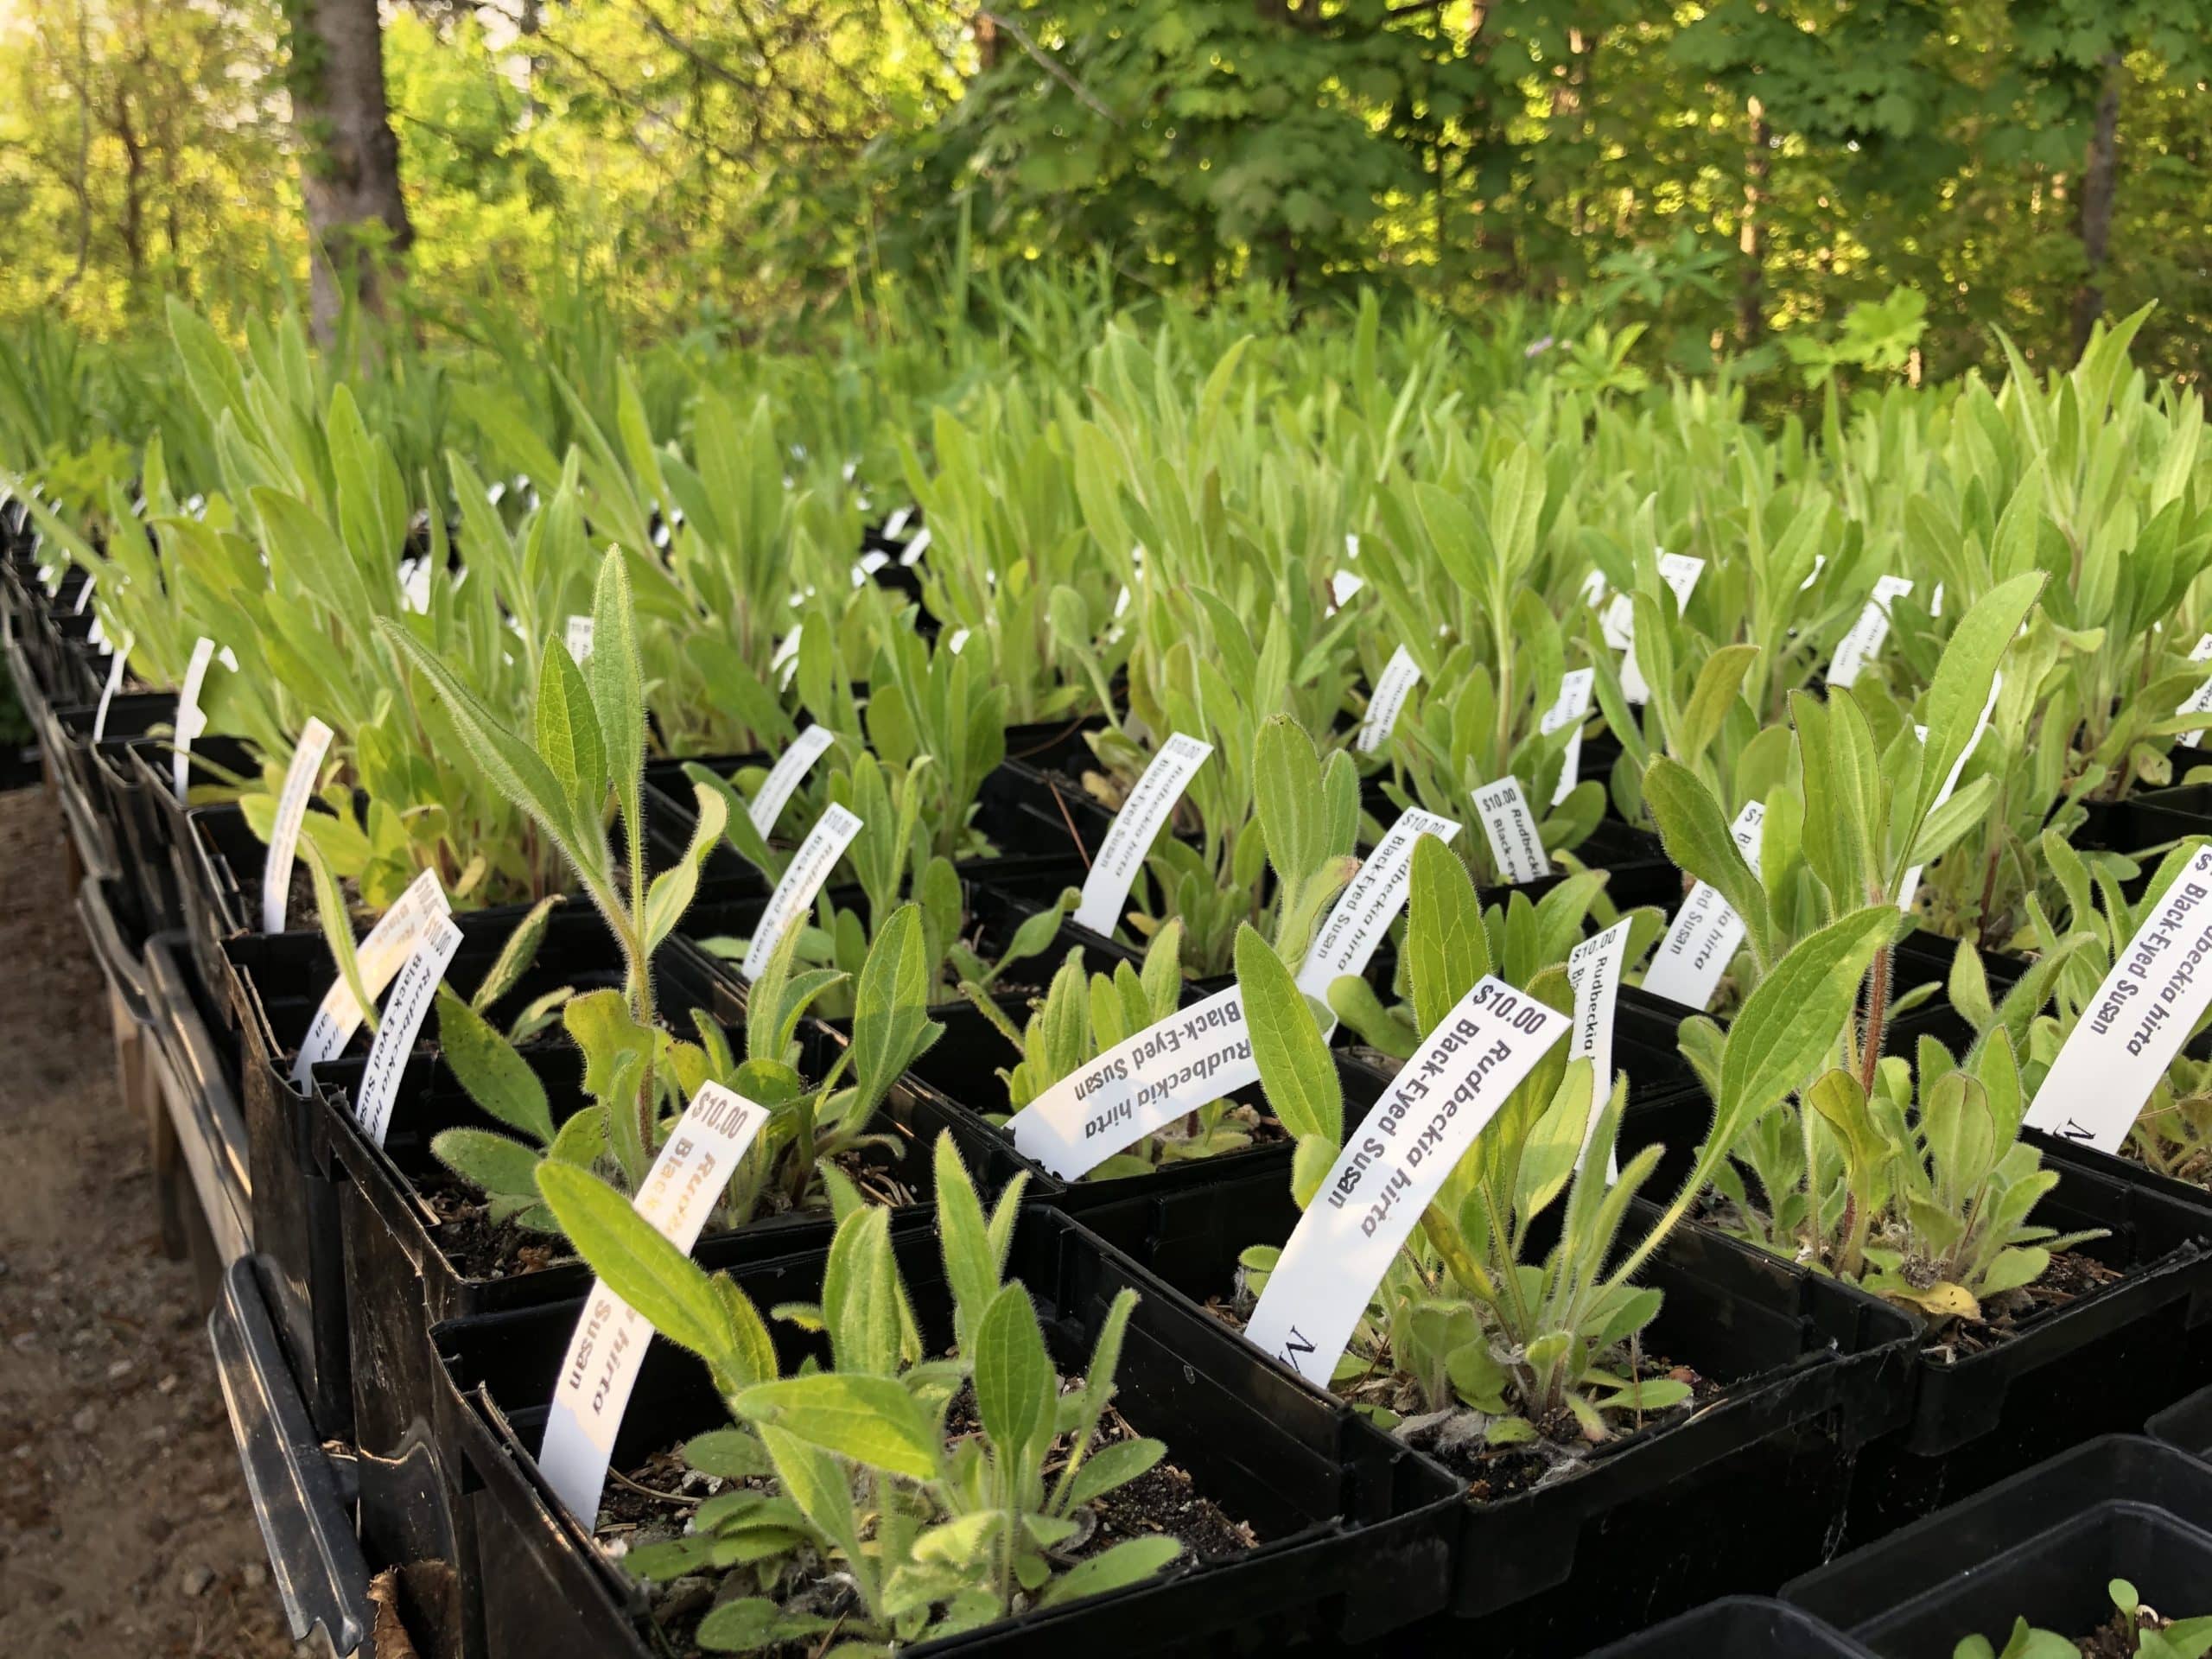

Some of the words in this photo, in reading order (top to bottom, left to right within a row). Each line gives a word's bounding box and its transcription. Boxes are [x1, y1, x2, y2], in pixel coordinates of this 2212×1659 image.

[1483, 787, 1516, 812] $10.00
[1346, 836, 1406, 910] Black-Eyed
[1511, 808, 1541, 876] Rudbecki
[1317, 914, 1351, 959] Susan
[1338, 928, 1366, 971] hirta
[1572, 929, 1617, 963] $10.00
[1670, 911, 1704, 956] Susan
[1694, 930, 1724, 971] hirta
[2127, 882, 2209, 980] Black-Eyed
[374, 951, 423, 1071] Black-Eyed
[1471, 983, 1548, 1036] $10.00
[1584, 956, 1608, 1052] Rudbeckia
[2089, 979, 2139, 1036] Susan
[2126, 1002, 2171, 1058] hirta
[1134, 1001, 1242, 1070] Black-Eyed
[358, 1078, 375, 1126] Susa
[1073, 1058, 1129, 1102] Susan
[1137, 1039, 1253, 1108] Rudbeckia
[1377, 1017, 1480, 1136] Black-Eyed
[1406, 1039, 1512, 1169] Rudbeckia
[691, 1090, 750, 1140] $10.00
[1084, 1101, 1133, 1140] hirta
[1327, 1136, 1387, 1211] Susan
[1361, 1166, 1414, 1239] hirta
[568, 1299, 612, 1391] Susan
[593, 1325, 630, 1417] hirta
